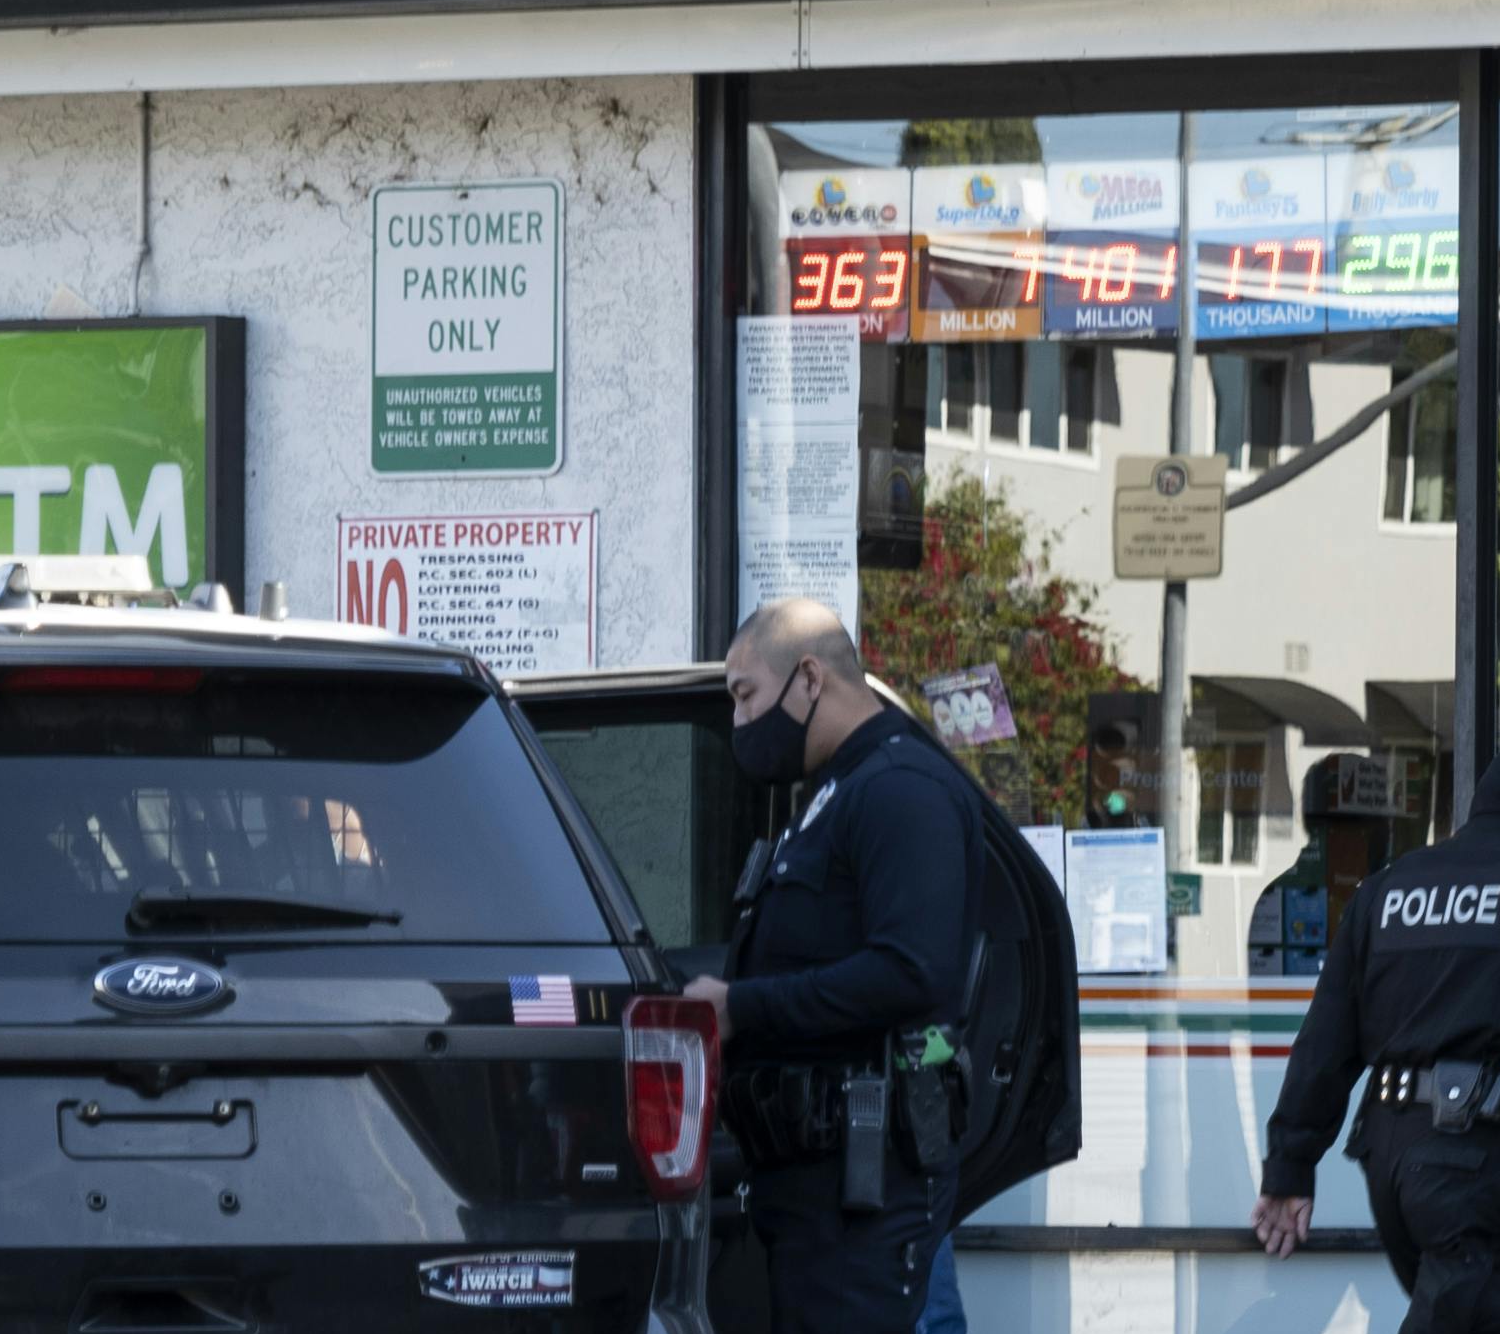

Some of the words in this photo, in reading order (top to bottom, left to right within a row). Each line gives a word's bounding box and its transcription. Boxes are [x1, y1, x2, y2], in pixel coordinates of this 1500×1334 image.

[1100, 173, 1162, 201] MEGA
[1215, 200, 1280, 219] Fantasy
[1282, 195, 1299, 217] 5
[388, 211, 543, 248] CUSTOMER
[1060, 243, 1177, 302] 401
[1227, 237, 1323, 301] 177
[1342, 230, 1459, 295] 296
[403, 265, 527, 300] PARKING
[794, 249, 908, 310] 363
[940, 311, 1016, 331] MILLION
[1075, 307, 1152, 329] MILLION
[1206, 305, 1316, 328] THOUSAND
[429, 318, 501, 352] ONLY
[386, 387, 478, 405] UNAUTHORIZED
[484, 385, 542, 402] VEHICLES
[386, 410, 414, 426] WILL
[419, 409, 435, 425] BE
[442, 408, 482, 425] TOWED
[488, 407, 521, 423] AWAY
[527, 407, 542, 422] AT
[379, 430, 429, 447] VEHICLE
[435, 429, 488, 446] OWNER'S
[493, 428, 549, 445] EXPENSE
[348, 523, 447, 550] PRIVATE
[453, 520, 583, 548] PROPERTY
[419, 554, 525, 565] TRESPASSING
[418, 569, 445, 580] P.C.
[450, 569, 482, 580] SEC.
[485, 569, 515, 579] 602
[518, 568, 538, 579] (L)
[347, 558, 408, 635] NO
[418, 584, 501, 596] LOITERING
[418, 599, 445, 611] P.C.
[450, 599, 482, 610] SEC.
[485, 599, 514, 609] 647
[518, 598, 539, 610] (G)
[418, 614, 496, 625] DRINKING
[418, 629, 444, 641] P.C.
[450, 629, 482, 640] SEC.
[485, 629, 514, 639] 647
[517, 628, 559, 640] (F+G)
[126, 964, 196, 997] Ford
